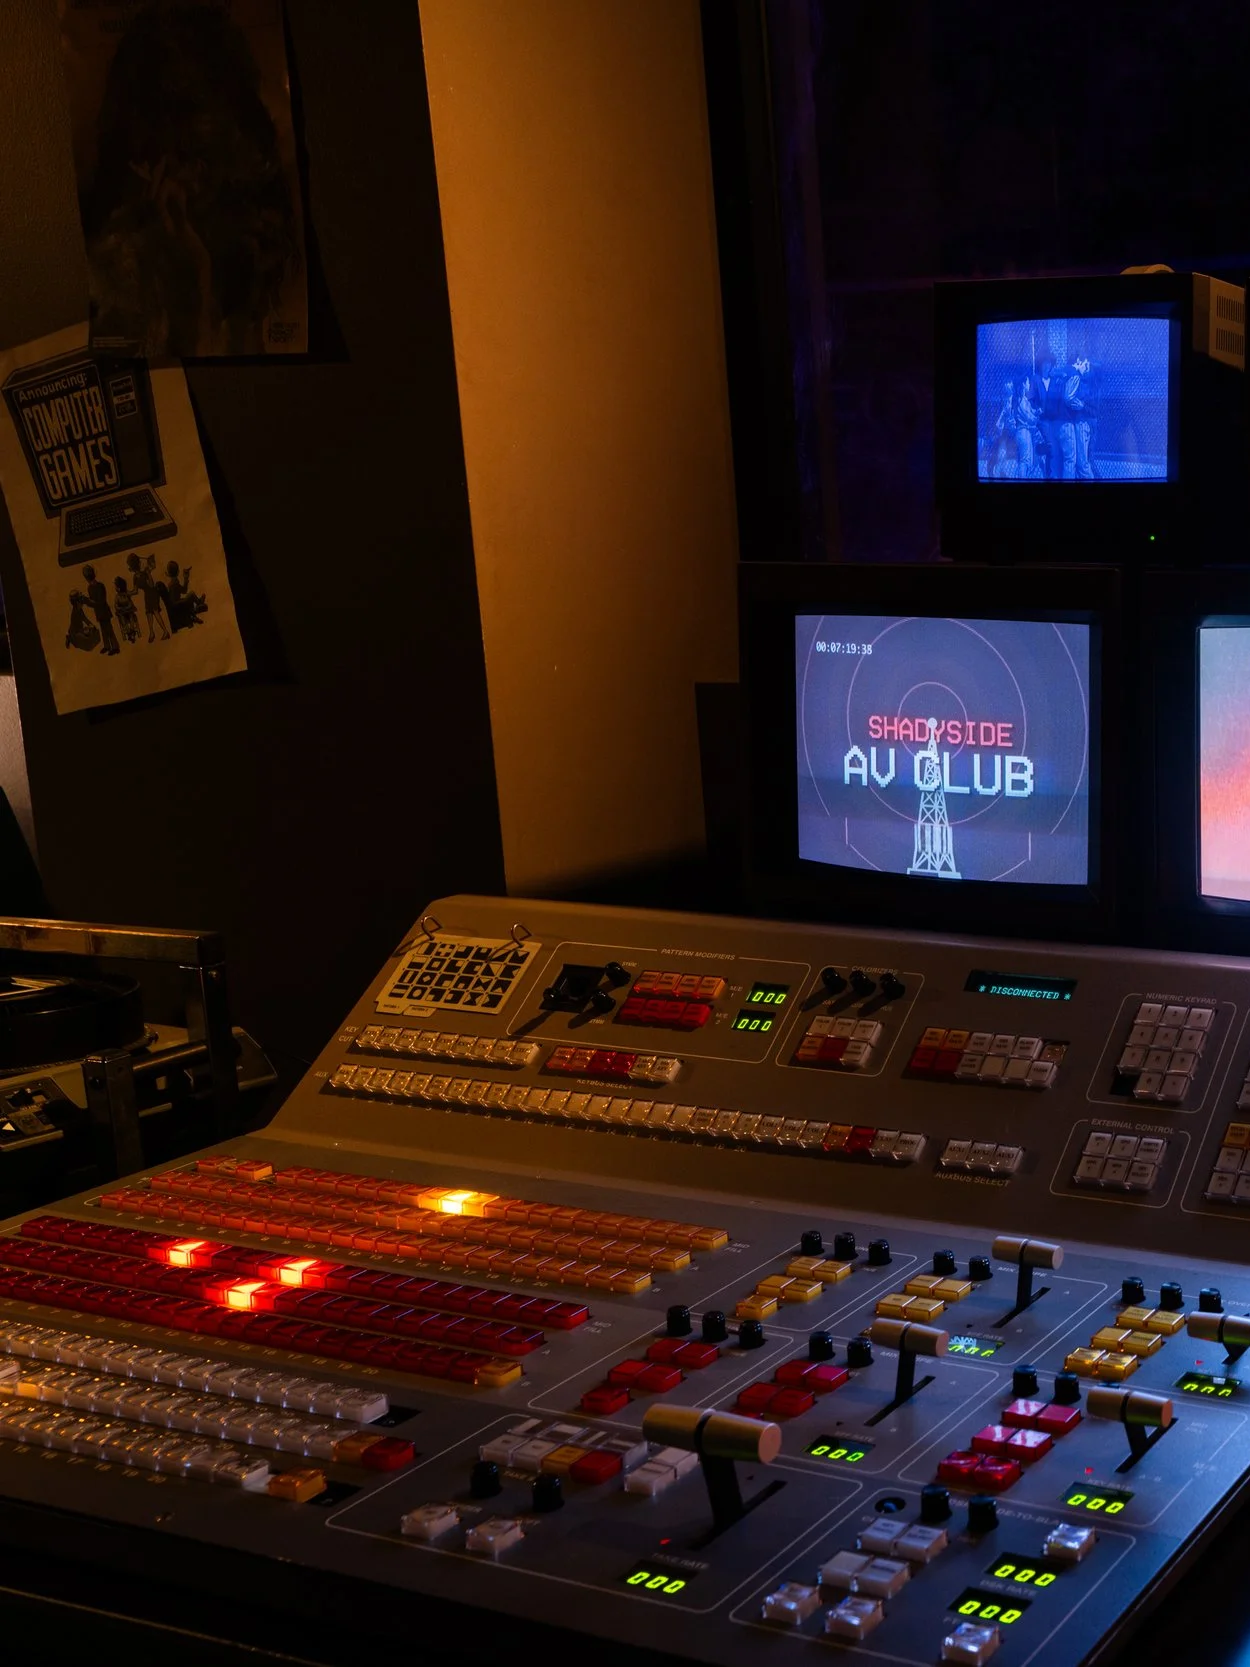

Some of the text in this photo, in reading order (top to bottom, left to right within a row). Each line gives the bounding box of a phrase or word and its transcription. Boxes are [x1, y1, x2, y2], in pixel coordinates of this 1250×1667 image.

[18, 371, 88, 403] Announcing:
[22, 385, 108, 452] COMPUTER
[38, 435, 118, 500] GAMES
[816, 641, 873, 655] 00:07:19:38
[868, 715, 1013, 747] SHADYSIDE
[844, 745, 1034, 797] AV CLUB
[660, 948, 736, 961] PATTERN MODIFIERS
[751, 991, 787, 1004] 000
[990, 984, 1060, 1000] DISCONNECTED
[1146, 992, 1217, 1005] NUMERIC KEYPAD
[737, 1018, 773, 1031] 000
[1091, 1118, 1175, 1134] EXTERNAL CONTROL
[935, 1171, 1012, 1188] AUXBUS SELECT
[811, 1444, 865, 1463] 000
[1067, 1493, 1125, 1515] 000
[996, 1507, 1060, 1525] DE-TO-BLA
[627, 1570, 687, 1595] 000
[994, 1563, 1057, 1588] 000
[958, 1599, 1023, 1625] 000
